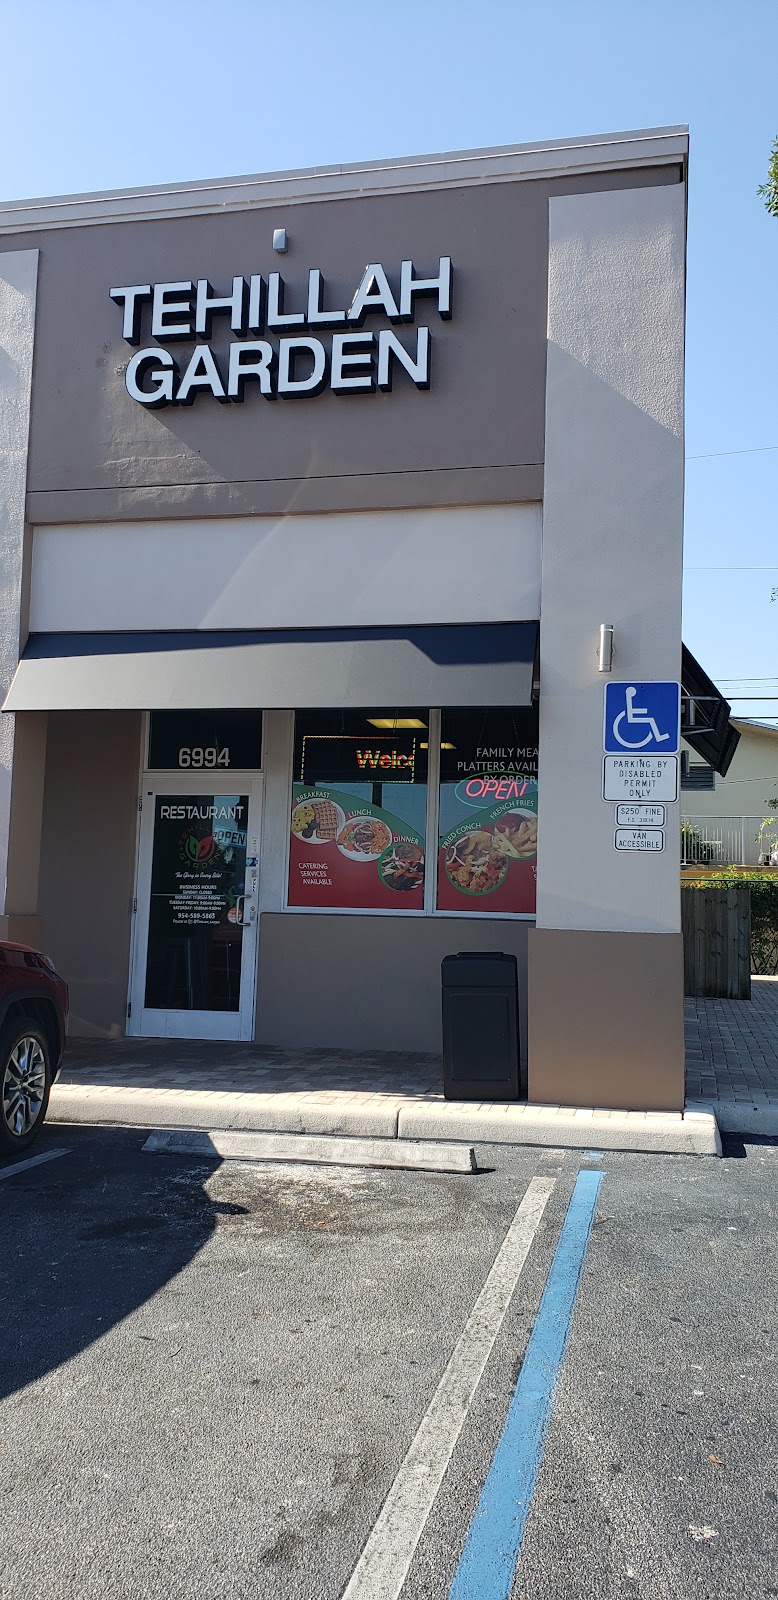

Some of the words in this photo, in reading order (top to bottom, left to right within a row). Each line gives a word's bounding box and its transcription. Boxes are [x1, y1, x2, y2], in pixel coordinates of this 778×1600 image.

[109, 256, 453, 342] TEHILLAH
[125, 326, 431, 405] GARDEN
[179, 747, 230, 767] 6994
[476, 748, 514, 758] FAMILY
[457, 762, 505, 771] PLATTERS
[657, 760, 667, 768] BY
[619, 770, 662, 778] DISABLED
[483, 775, 497, 784] BY
[500, 775, 536, 785] ORDER
[466, 779, 526, 799] OPEN
[296, 791, 331, 803] BREAKFAST
[160, 805, 244, 820] RESTAURANT
[348, 808, 372, 818] LUNCH
[489, 802, 515, 820] FRENCH
[217, 829, 246, 846] OPEN
[393, 836, 419, 846] DINNER
[442, 833, 457, 850] FRIED
[456, 823, 482, 835] CONCH
[632, 832, 647, 840] VAN
[618, 840, 660, 849] ACCESSIBLE
[298, 862, 329, 870] CATERING
